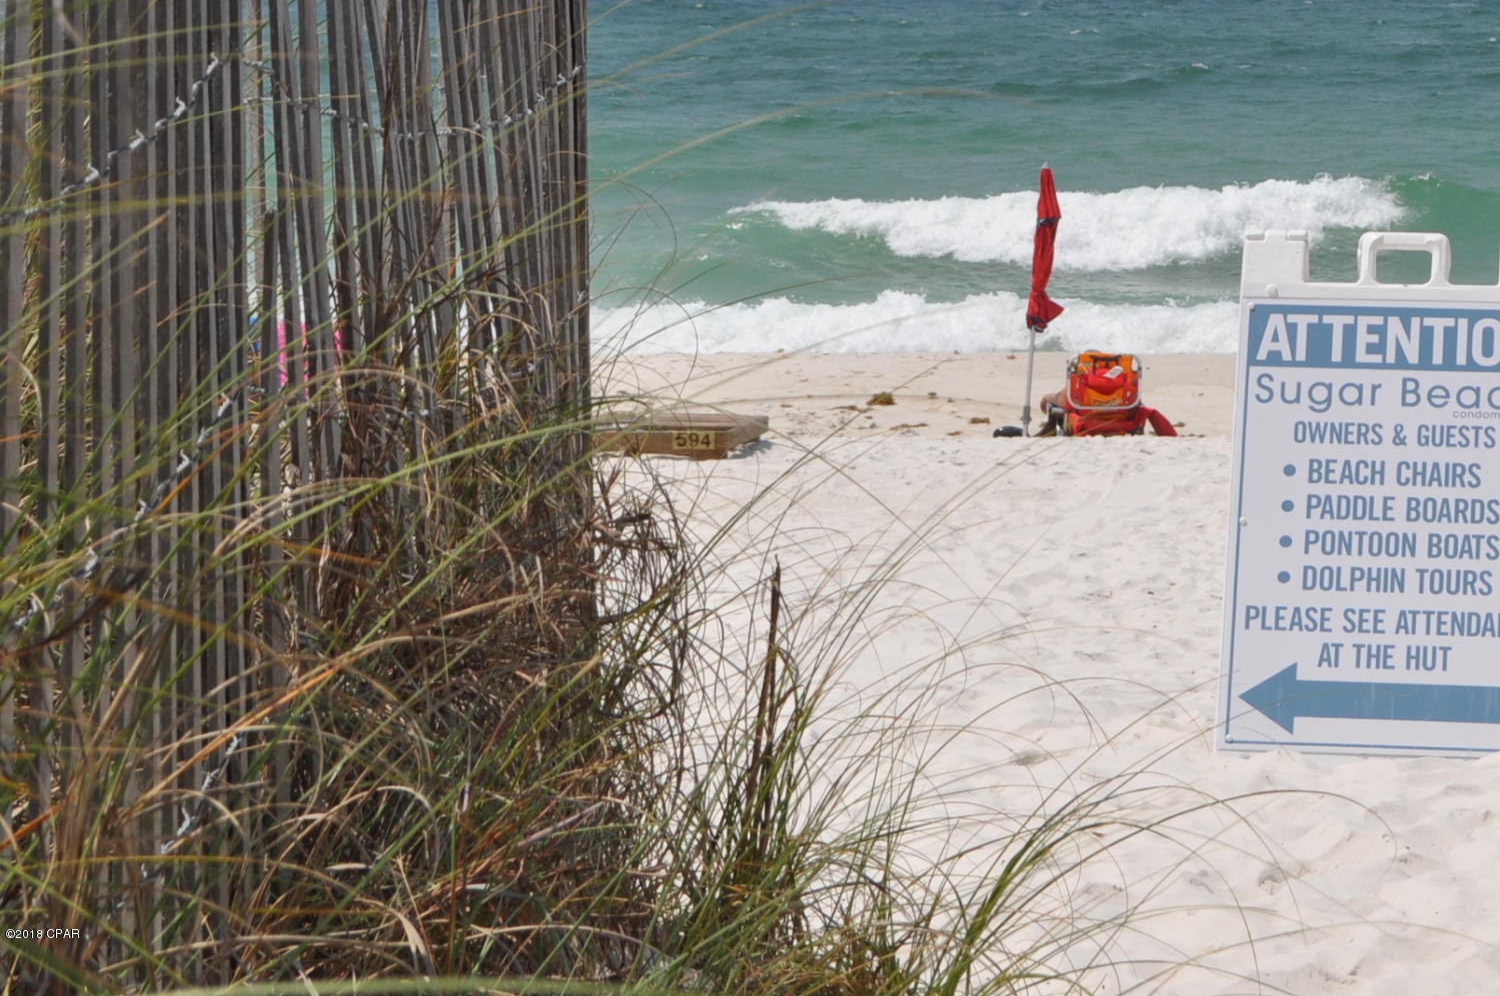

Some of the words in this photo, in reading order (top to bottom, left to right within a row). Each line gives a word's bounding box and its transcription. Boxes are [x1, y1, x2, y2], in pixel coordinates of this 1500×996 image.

[1254, 372, 1382, 414] Sugar
[674, 431, 712, 448] 594
[1293, 420, 1384, 446] OWNERS
[1391, 422, 1408, 447] &
[1416, 423, 1497, 449] GUESTS
[1307, 458, 1386, 486] BEACH
[1395, 460, 1482, 489] CHAIRS
[1305, 493, 1396, 522] PADDLE
[1405, 496, 1500, 525] BOARDS
[1303, 529, 1417, 558] PONTOON
[1427, 532, 1500, 561] BOATS
[1301, 564, 1406, 594] DOLPHIN
[1415, 568, 1493, 597] TOURS
[1244, 604, 1333, 633] PLEASE
[1342, 607, 1387, 635] SEE
[1317, 642, 1345, 669] AT
[1351, 643, 1396, 670] THE
[1405, 644, 1453, 672] HUT
